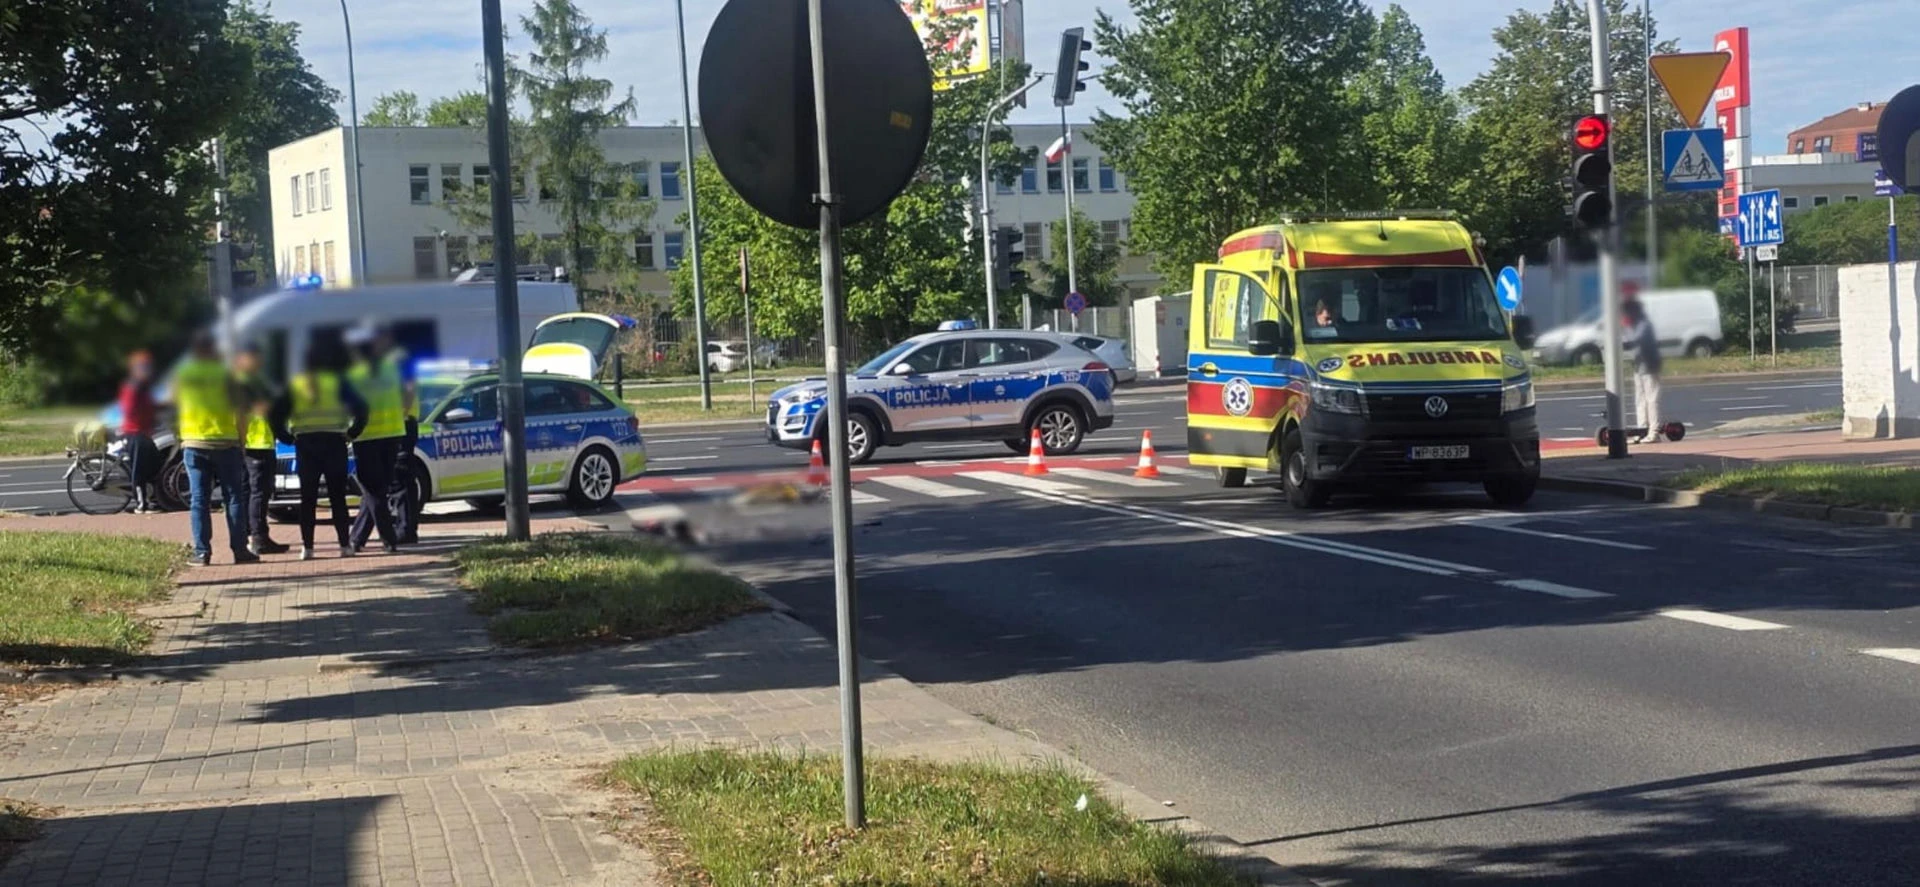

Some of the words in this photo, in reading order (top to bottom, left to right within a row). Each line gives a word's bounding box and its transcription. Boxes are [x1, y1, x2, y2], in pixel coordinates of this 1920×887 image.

[1767, 229, 1780, 240] BUS
[895, 388, 951, 404] POLICJA
[442, 434, 494, 454] POLICJA
[1415, 447, 1429, 458] WP
